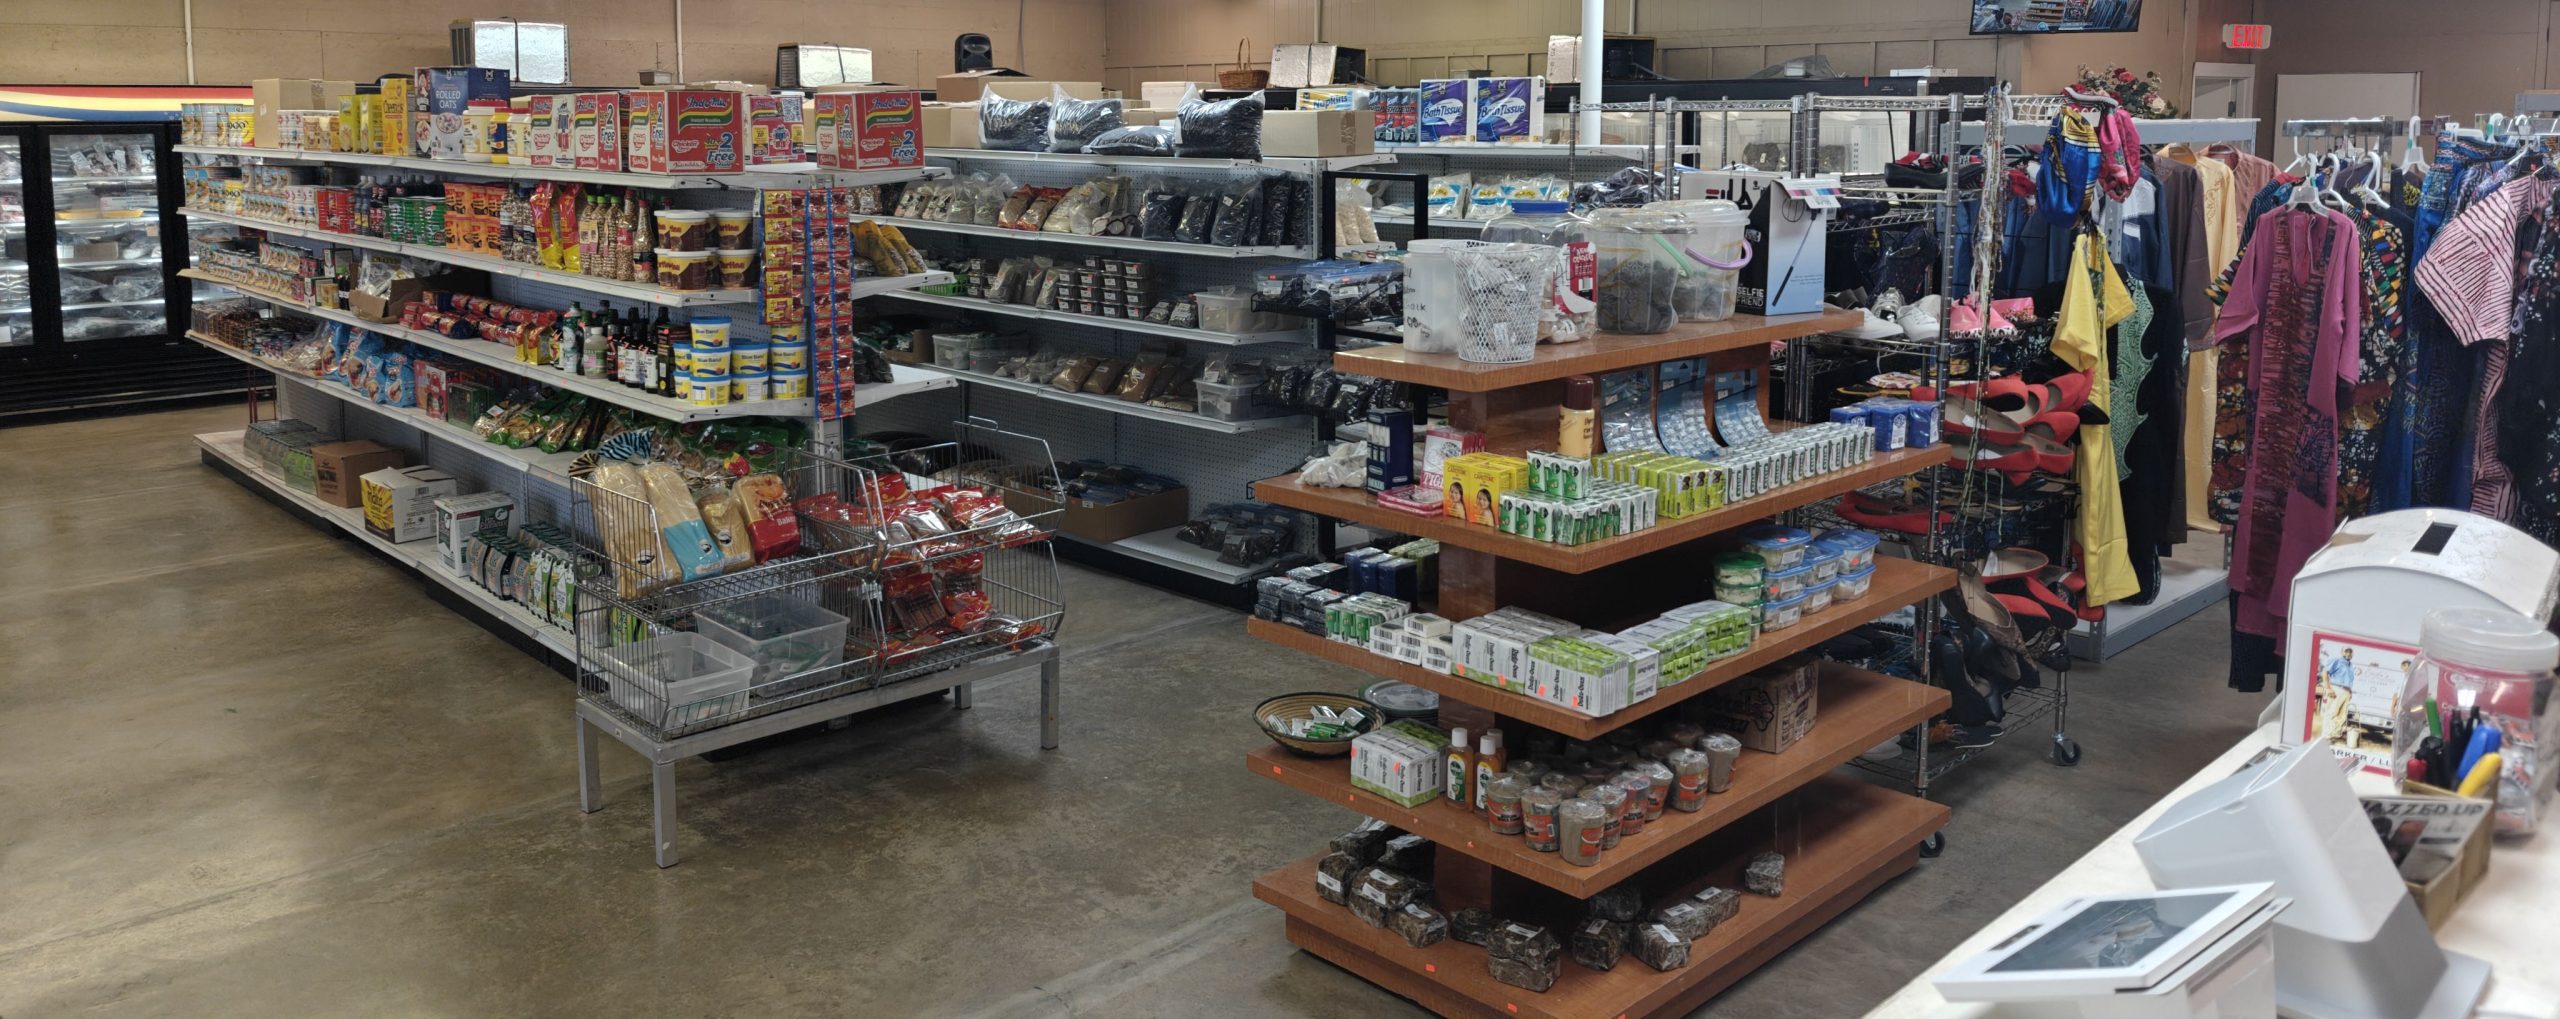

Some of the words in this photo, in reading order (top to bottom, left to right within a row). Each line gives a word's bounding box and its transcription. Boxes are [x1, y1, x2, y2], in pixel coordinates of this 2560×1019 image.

[2233, 25, 2263, 48] EXIT
[435, 90, 461, 99] ROLLED
[439, 100, 458, 109] OATS
[1313, 95, 1348, 110] Napkins
[1424, 106, 1440, 118] Bath
[1441, 104, 1463, 116] Tissue
[1481, 106, 1499, 117] Bath
[1500, 104, 1525, 116] Tissue
[719, 132, 734, 148] 2
[902, 130, 915, 145] 2
[707, 150, 736, 162] Free
[892, 148, 917, 159] Free
[1737, 286, 1764, 298] SELFIE
[1736, 297, 1764, 307] FRIEND
